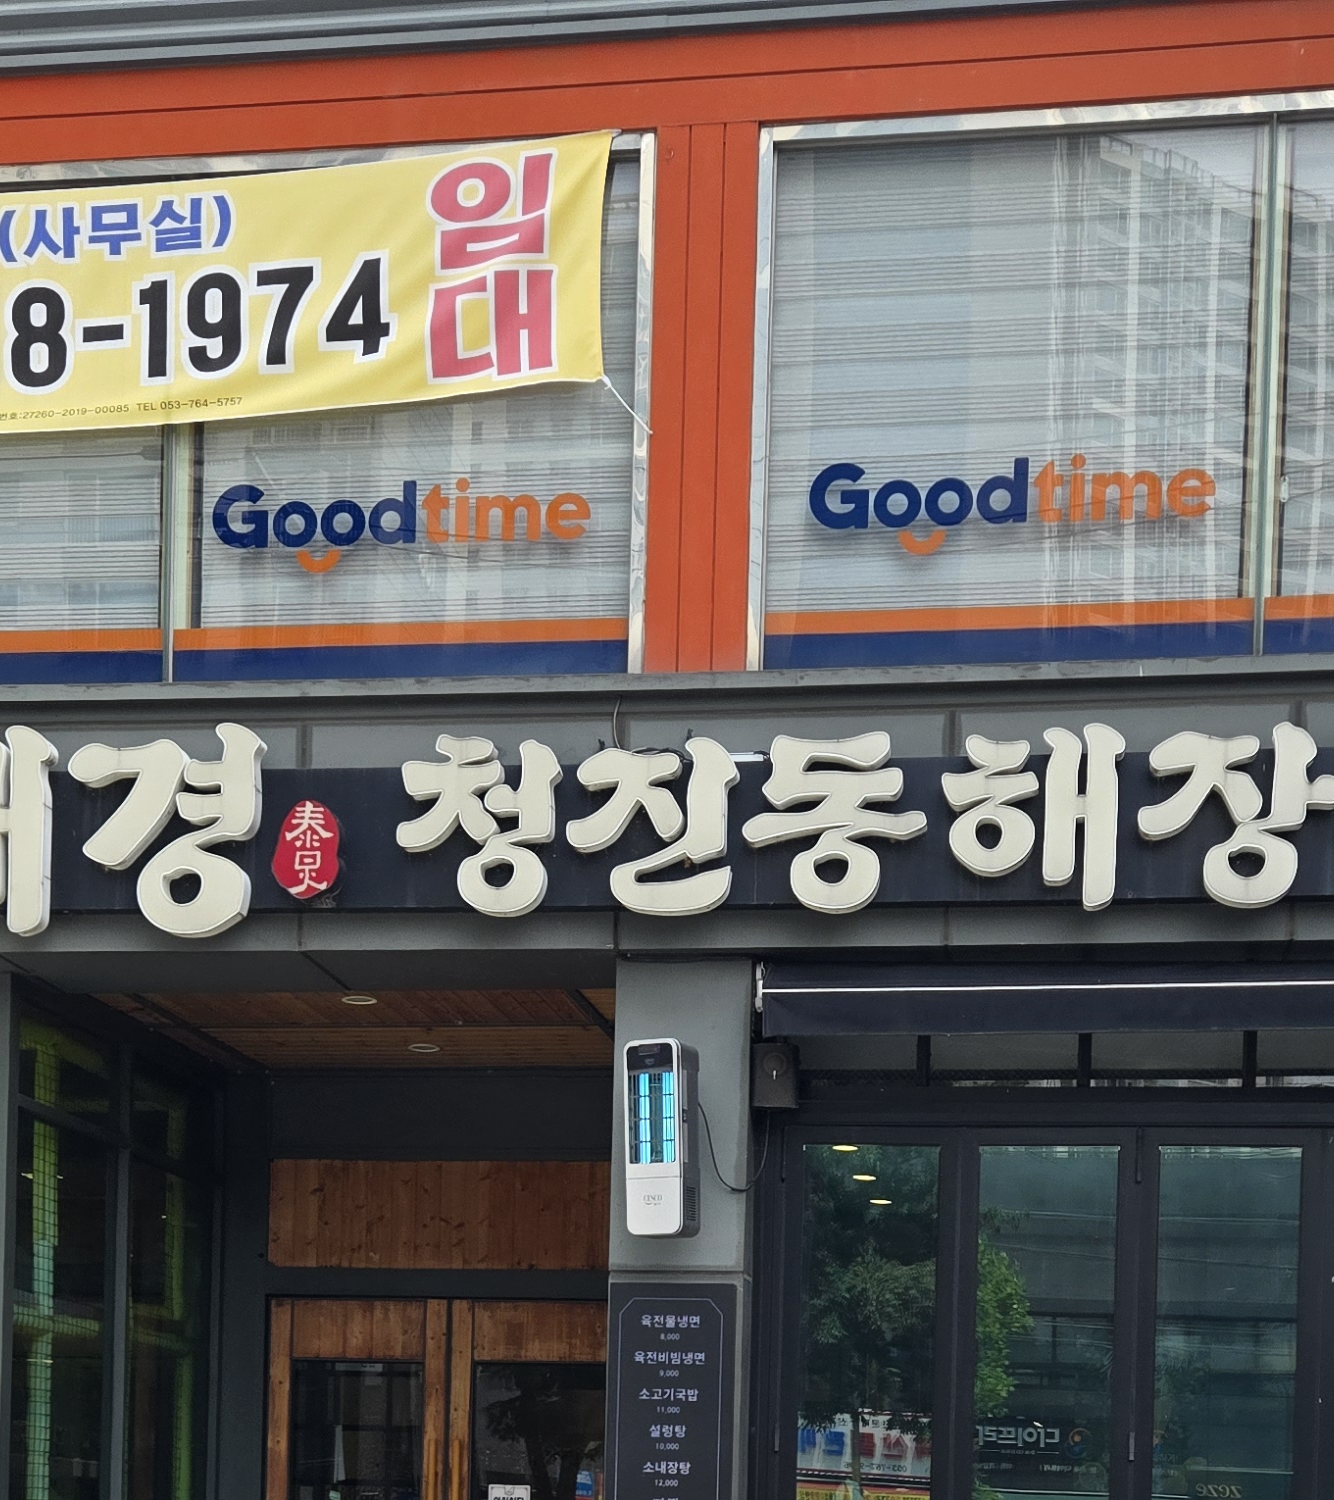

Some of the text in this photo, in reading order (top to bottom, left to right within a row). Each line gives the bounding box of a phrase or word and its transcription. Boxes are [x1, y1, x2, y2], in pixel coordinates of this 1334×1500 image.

[430, 153, 558, 380] 임대
[136, 402, 157, 412] TEL
[159, 397, 243, 410] 053-764-5757
[810, 453, 1217, 530] Goodtime
[212, 477, 592, 549] Goodtime
[634, 1351, 705, 1365] 육전비빔냉면
[638, 1388, 699, 1401] 소고기국밥
[656, 1406, 680, 1414] 11,000
[649, 1424, 686, 1438] 설렁탕
[655, 1443, 679, 1451] 10,000
[642, 1461, 691, 1475] 소내장탕
[655, 1479, 678, 1487] 12,000
